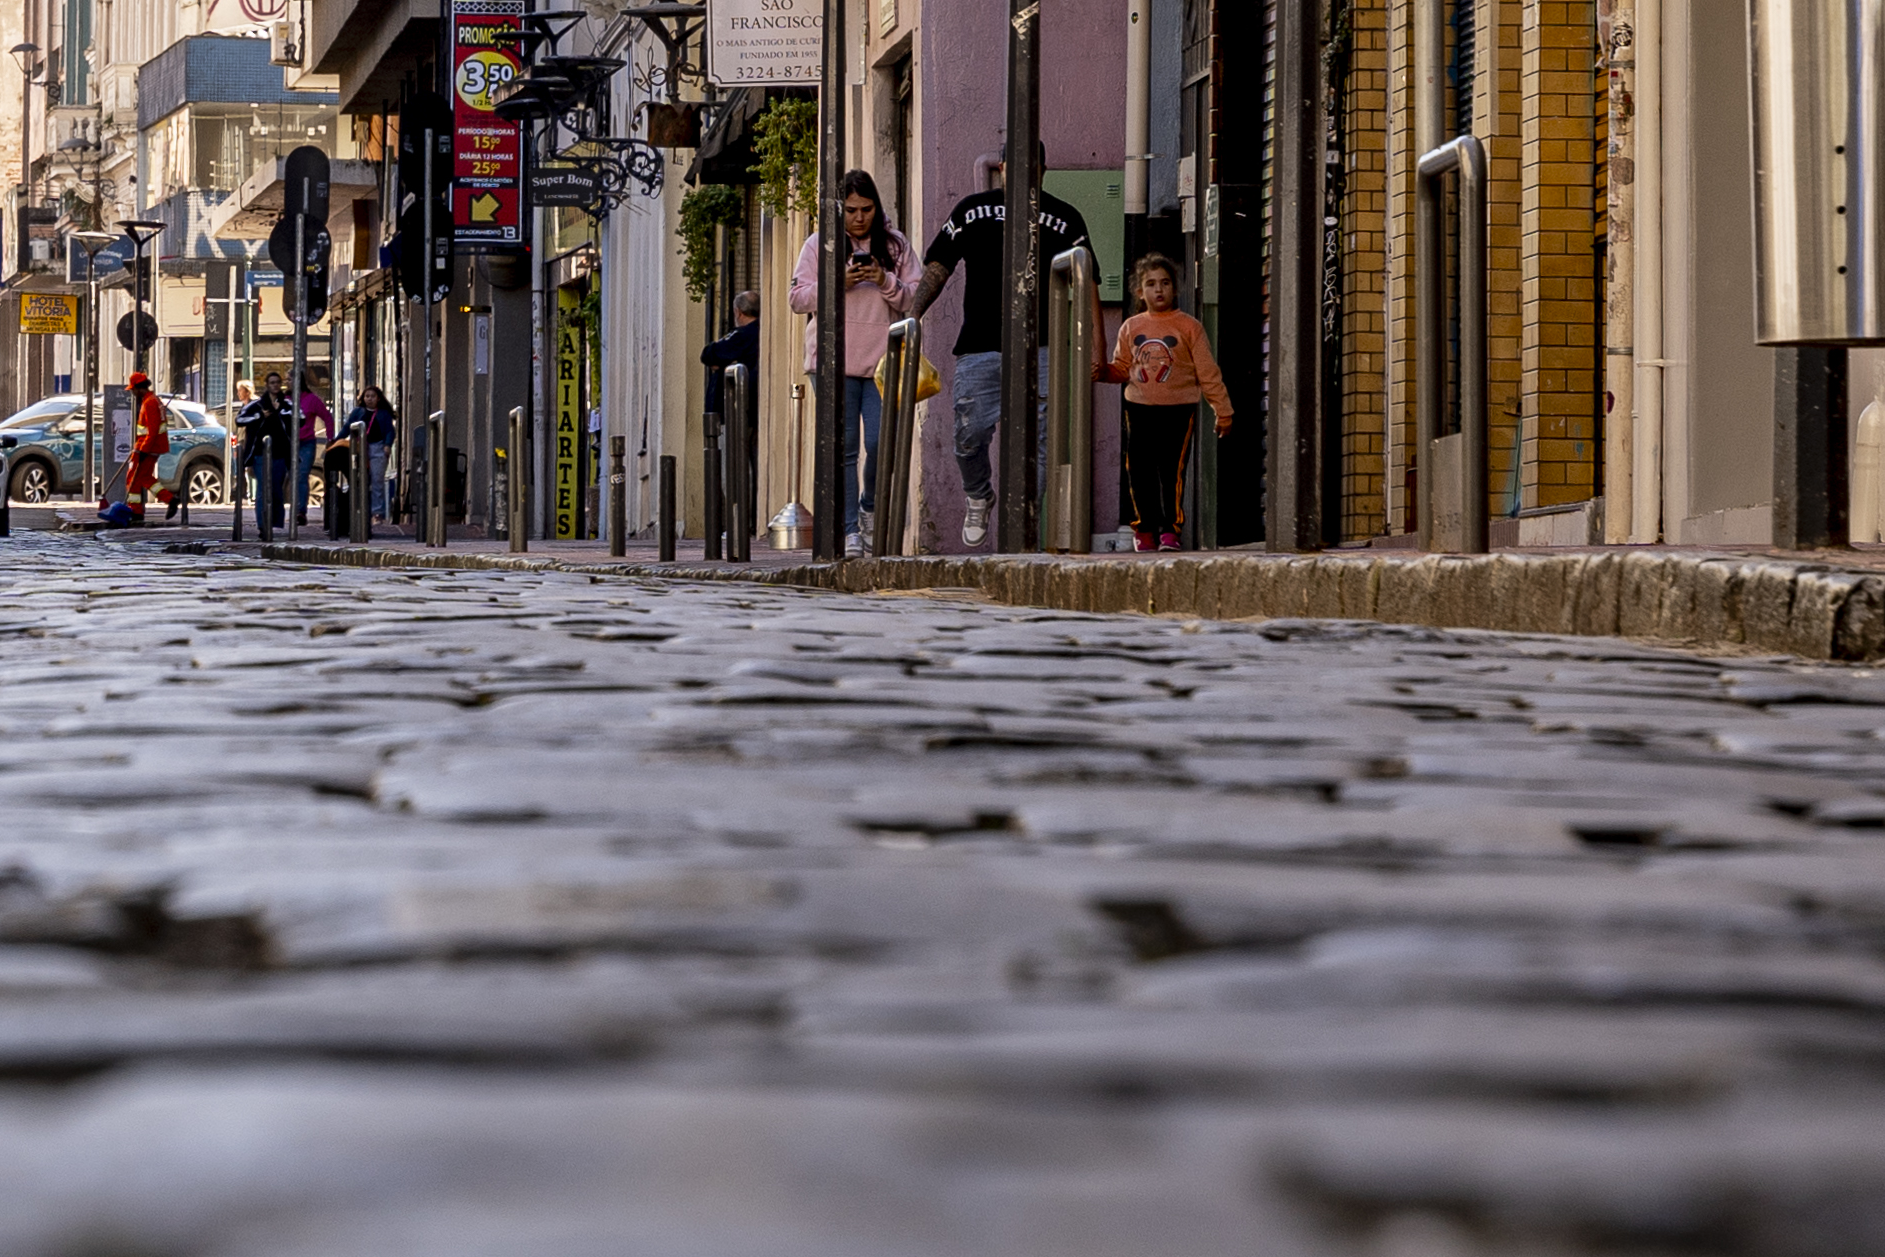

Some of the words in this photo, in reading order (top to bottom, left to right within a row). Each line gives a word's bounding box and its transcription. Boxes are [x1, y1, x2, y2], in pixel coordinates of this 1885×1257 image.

[730, 15, 823, 30] FRANCISCO
[750, 38, 784, 46] ANTIGO
[740, 51, 783, 59] FUNDADO
[736, 65, 823, 79] 3224-8745
[532, 176, 564, 187] Super
[567, 174, 593, 187] Bom
[29, 296, 65, 307] HOTEL
